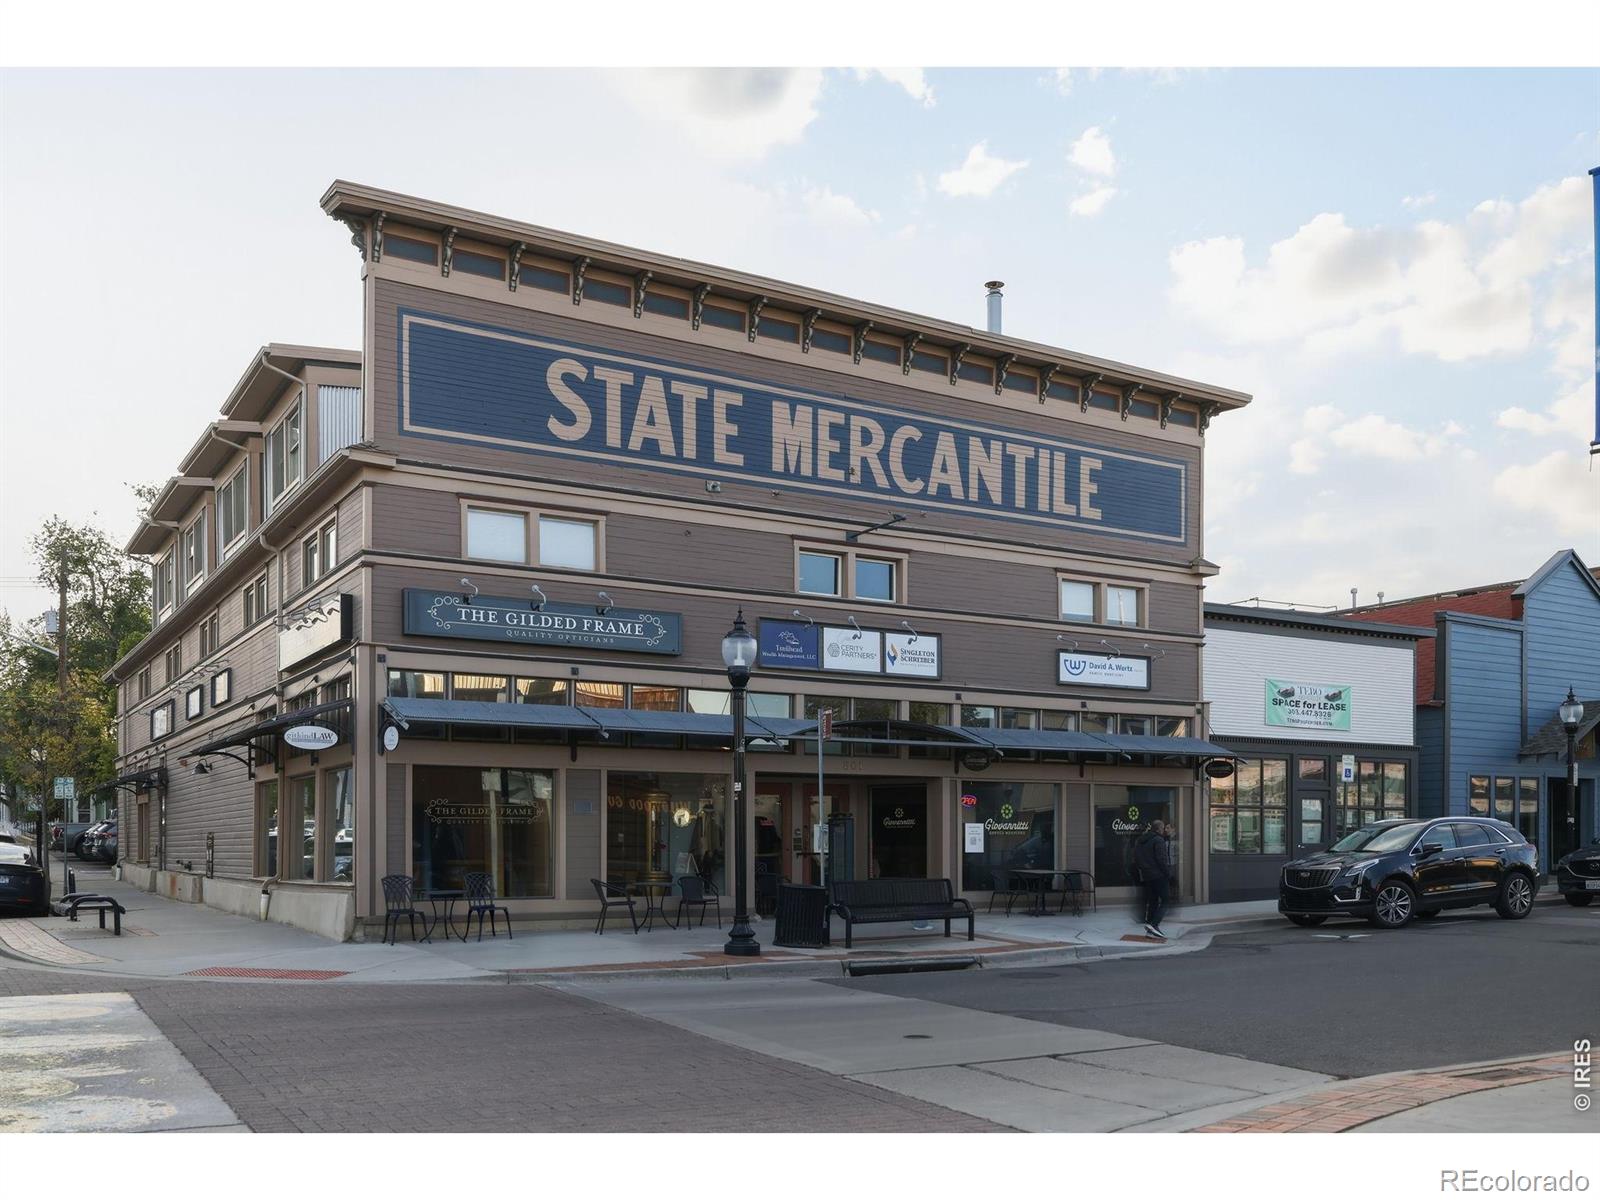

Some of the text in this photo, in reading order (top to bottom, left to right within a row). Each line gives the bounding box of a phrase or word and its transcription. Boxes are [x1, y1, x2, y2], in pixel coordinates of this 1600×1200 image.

[546, 358, 1102, 520] STATE MERCANTILE
[456, 607, 644, 636] THE GILDED FRAME
[505, 629, 553, 639] QUALITY
[840, 644, 864, 652] CERITY
[900, 647, 935, 657] SINGLETON
[1089, 662, 1107, 670] David
[1108, 663, 1114, 671] A.
[1272, 698, 1347, 711] SPACE for LEASE
[961, 797, 976, 806] OPEN
[435, 807, 456, 815] THE
